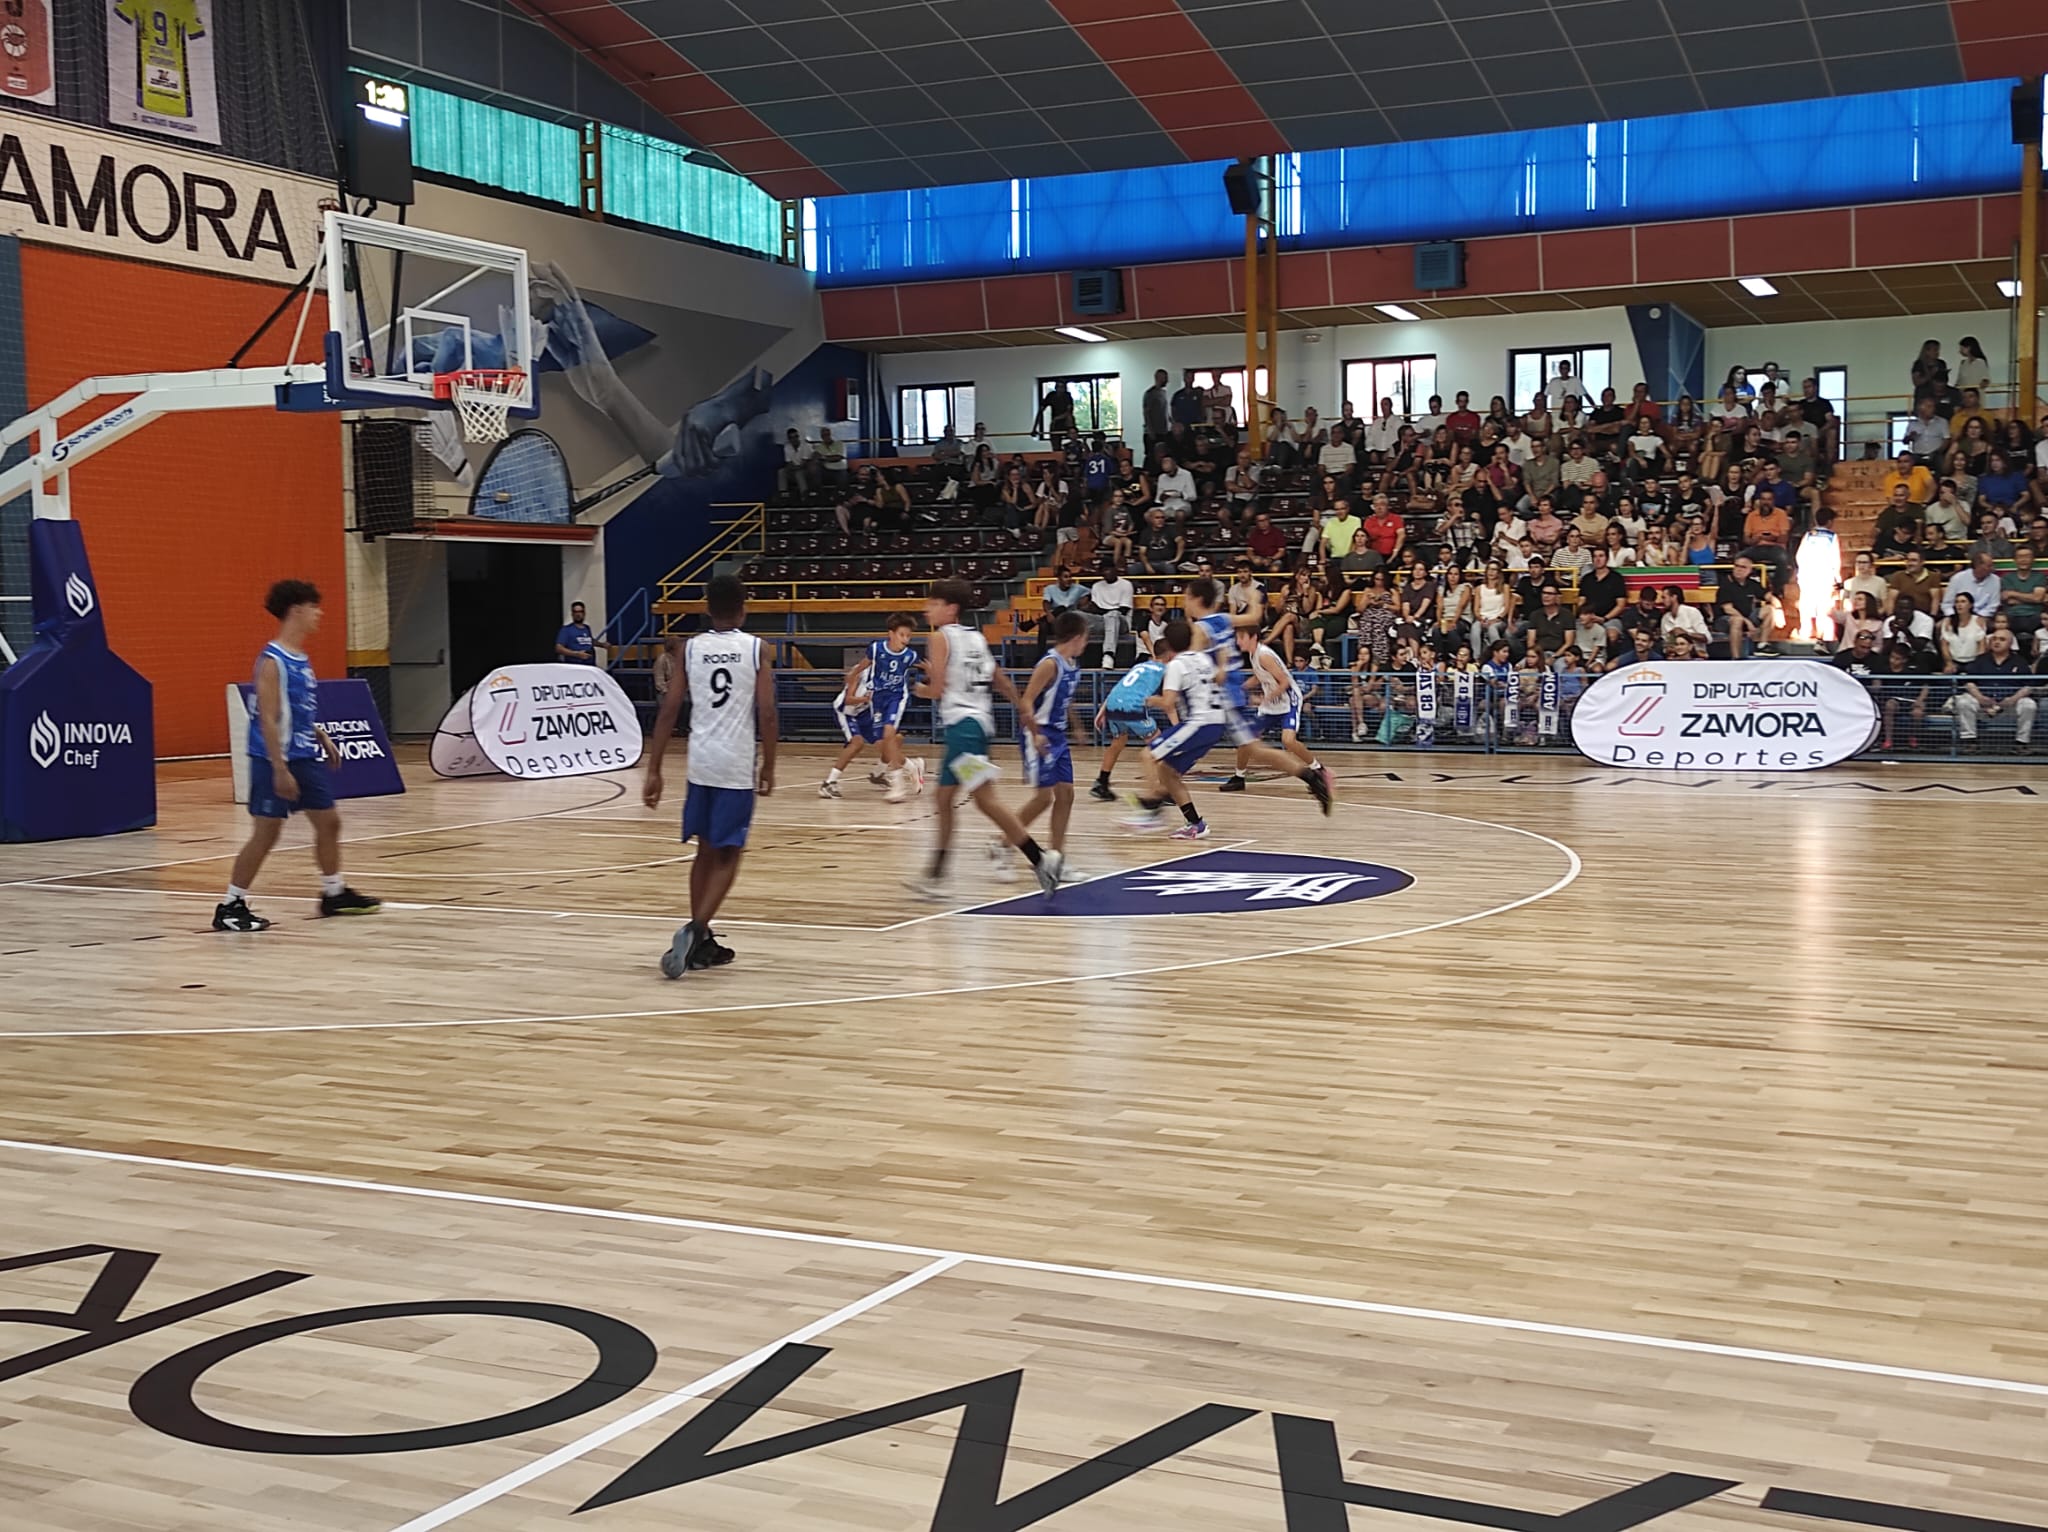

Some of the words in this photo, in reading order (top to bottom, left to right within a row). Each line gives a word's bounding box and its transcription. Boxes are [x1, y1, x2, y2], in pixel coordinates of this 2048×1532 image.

[153, 11, 168, 46] 9
[1089, 459, 1105, 474] 31
[703, 653, 741, 664] RODRI
[889, 659, 899, 673] 9
[710, 668, 732, 708] 9
[1123, 667, 1145, 687] 6
[64, 723, 132, 744] INNOVA
[531, 710, 618, 741] ZAMORA
[1680, 712, 1826, 738] ZAMORA
[64, 750, 100, 769] Chef
[505, 747, 627, 776] Deportes
[1612, 745, 1824, 768] Deportes
